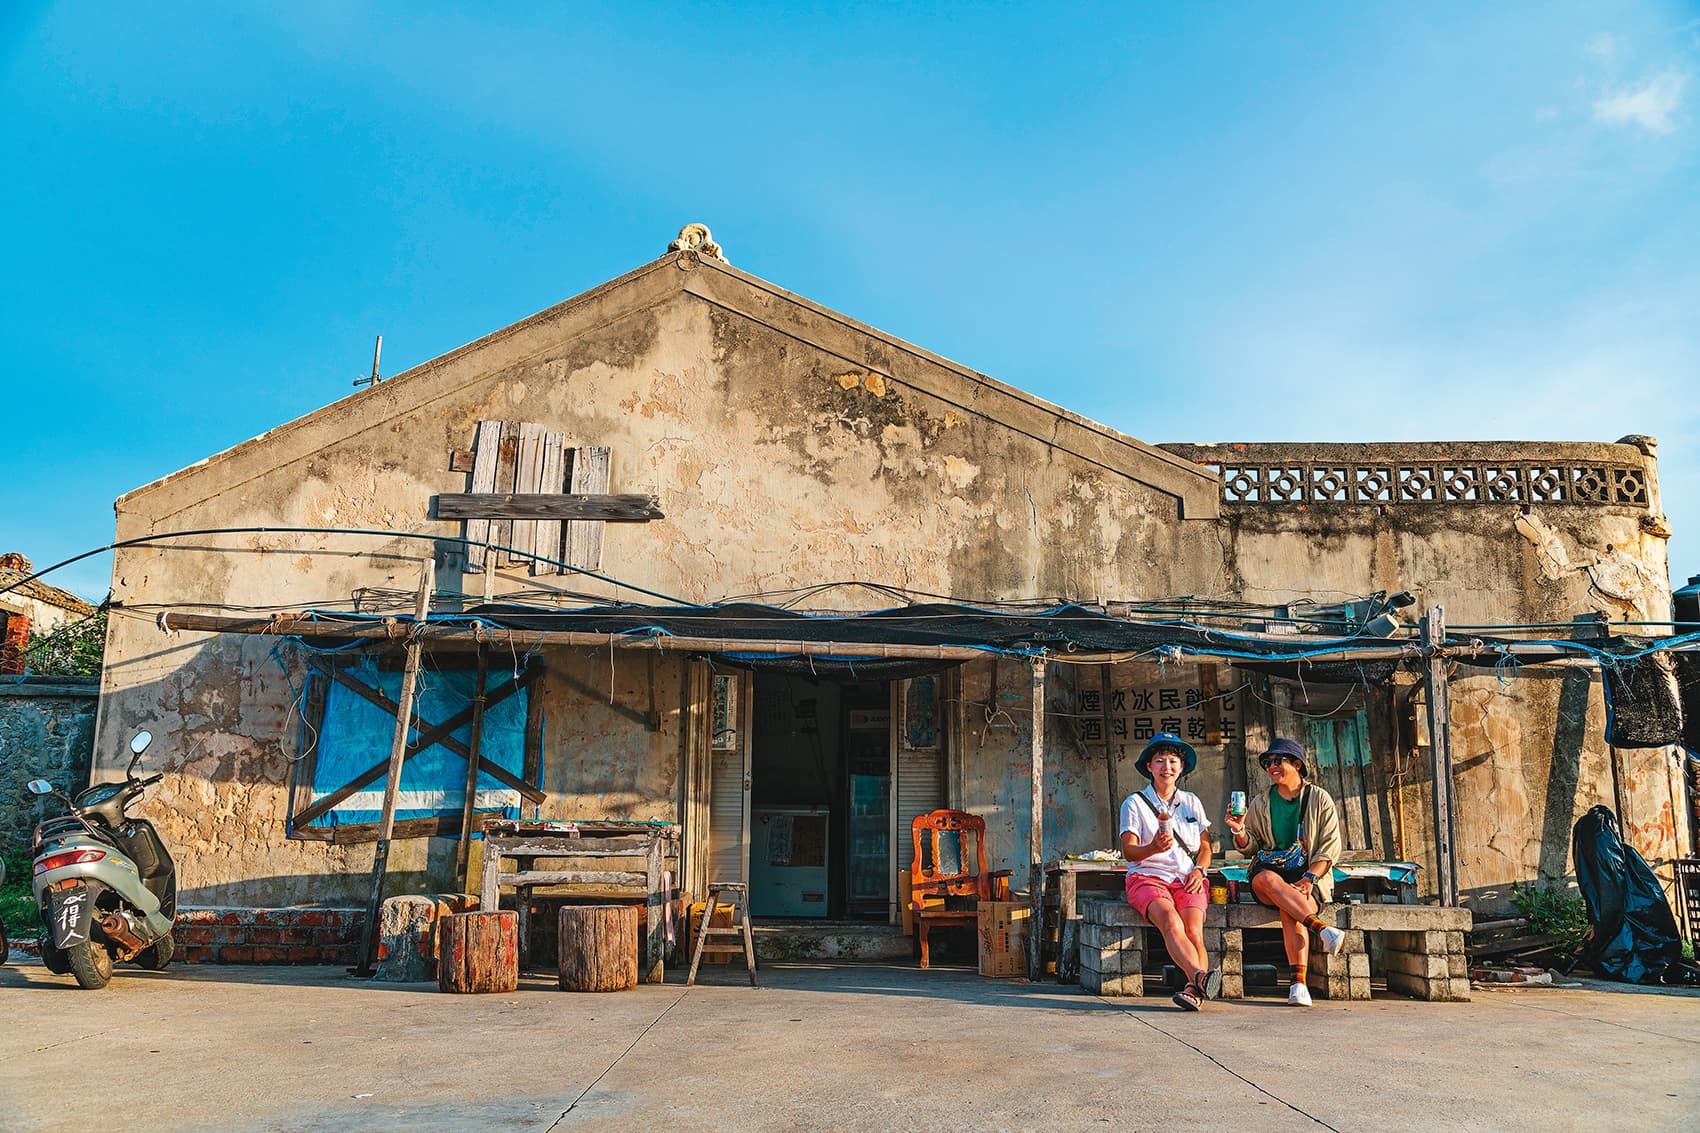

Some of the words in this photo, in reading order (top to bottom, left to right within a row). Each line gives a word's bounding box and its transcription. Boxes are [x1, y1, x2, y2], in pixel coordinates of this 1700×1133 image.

[1079, 689, 1101, 740] 煙酒
[1132, 689, 1155, 740] 冰品
[1160, 689, 1182, 738] 民宿
[57, 904, 84, 947] 得人
